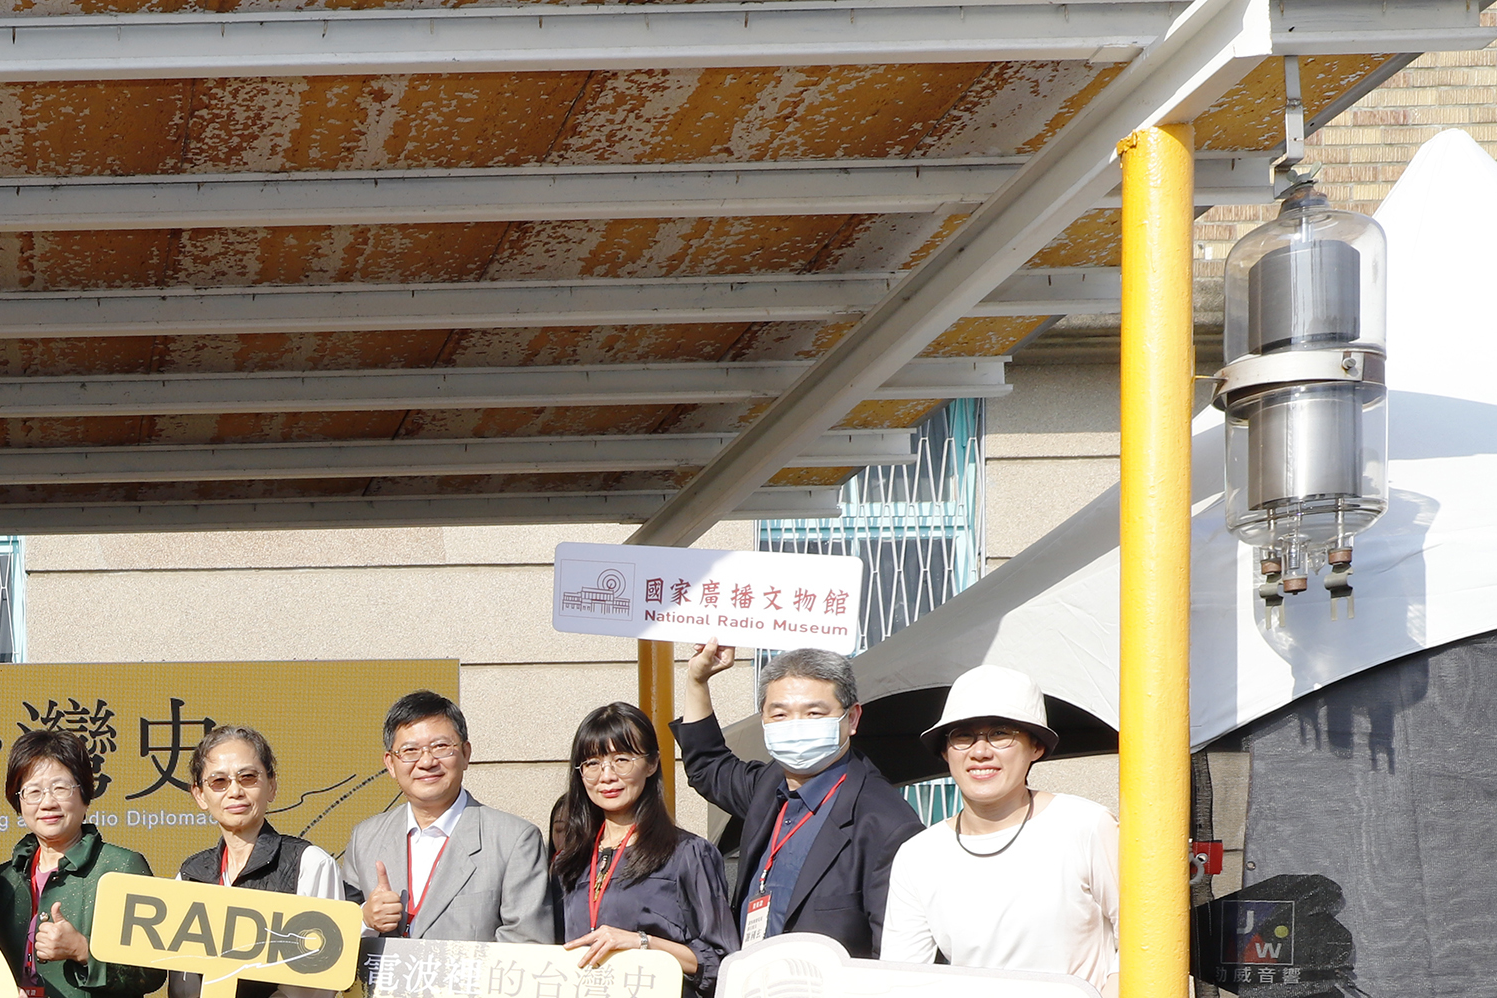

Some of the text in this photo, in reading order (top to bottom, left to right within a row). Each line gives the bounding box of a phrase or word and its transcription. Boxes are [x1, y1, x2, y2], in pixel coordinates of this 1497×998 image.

[644, 578, 850, 616] 國家廣播文物館
[644, 609, 848, 636] National Radio Museum
[126, 810, 219, 829] Diplomac
[120, 892, 345, 974] RADIO
